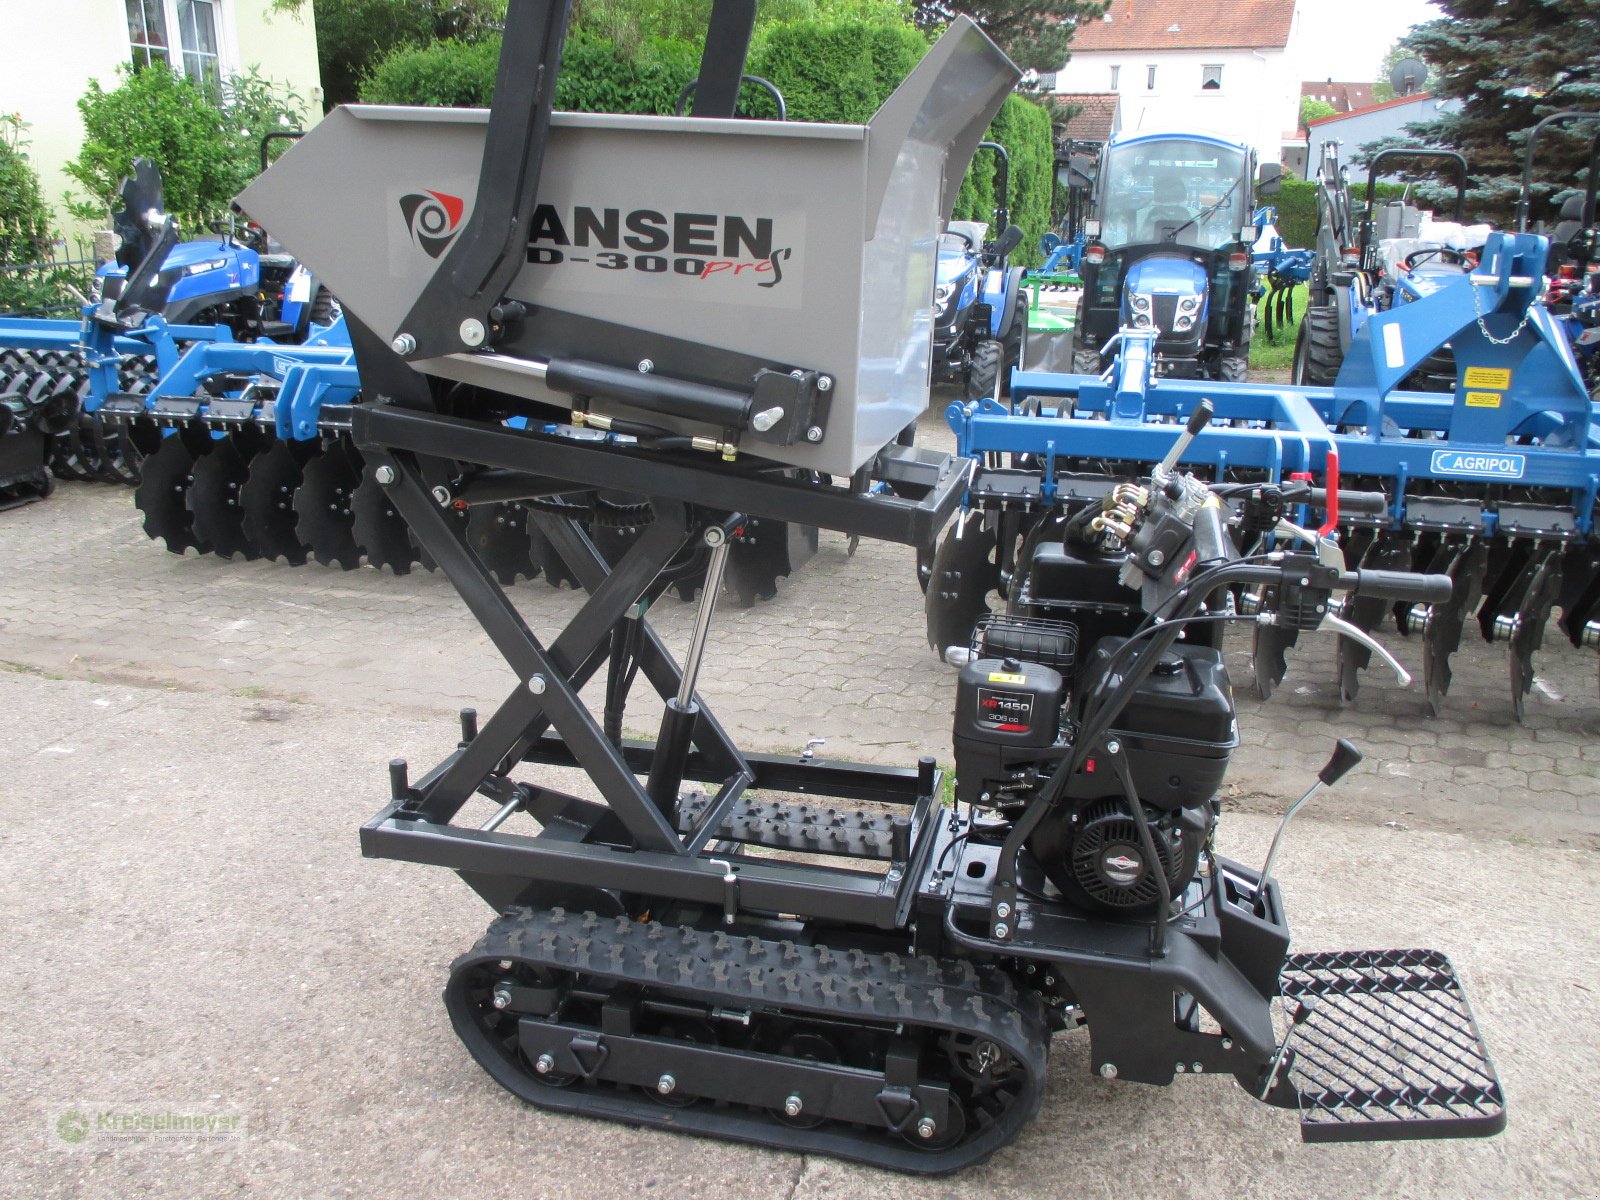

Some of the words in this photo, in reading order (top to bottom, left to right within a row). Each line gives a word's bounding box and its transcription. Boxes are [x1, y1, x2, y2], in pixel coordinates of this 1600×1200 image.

[528, 203, 772, 260] ANSEN
[1453, 456, 1519, 473] AGRIPOL
[982, 699, 1030, 711] XR1450
[988, 713, 1008, 722] 306
